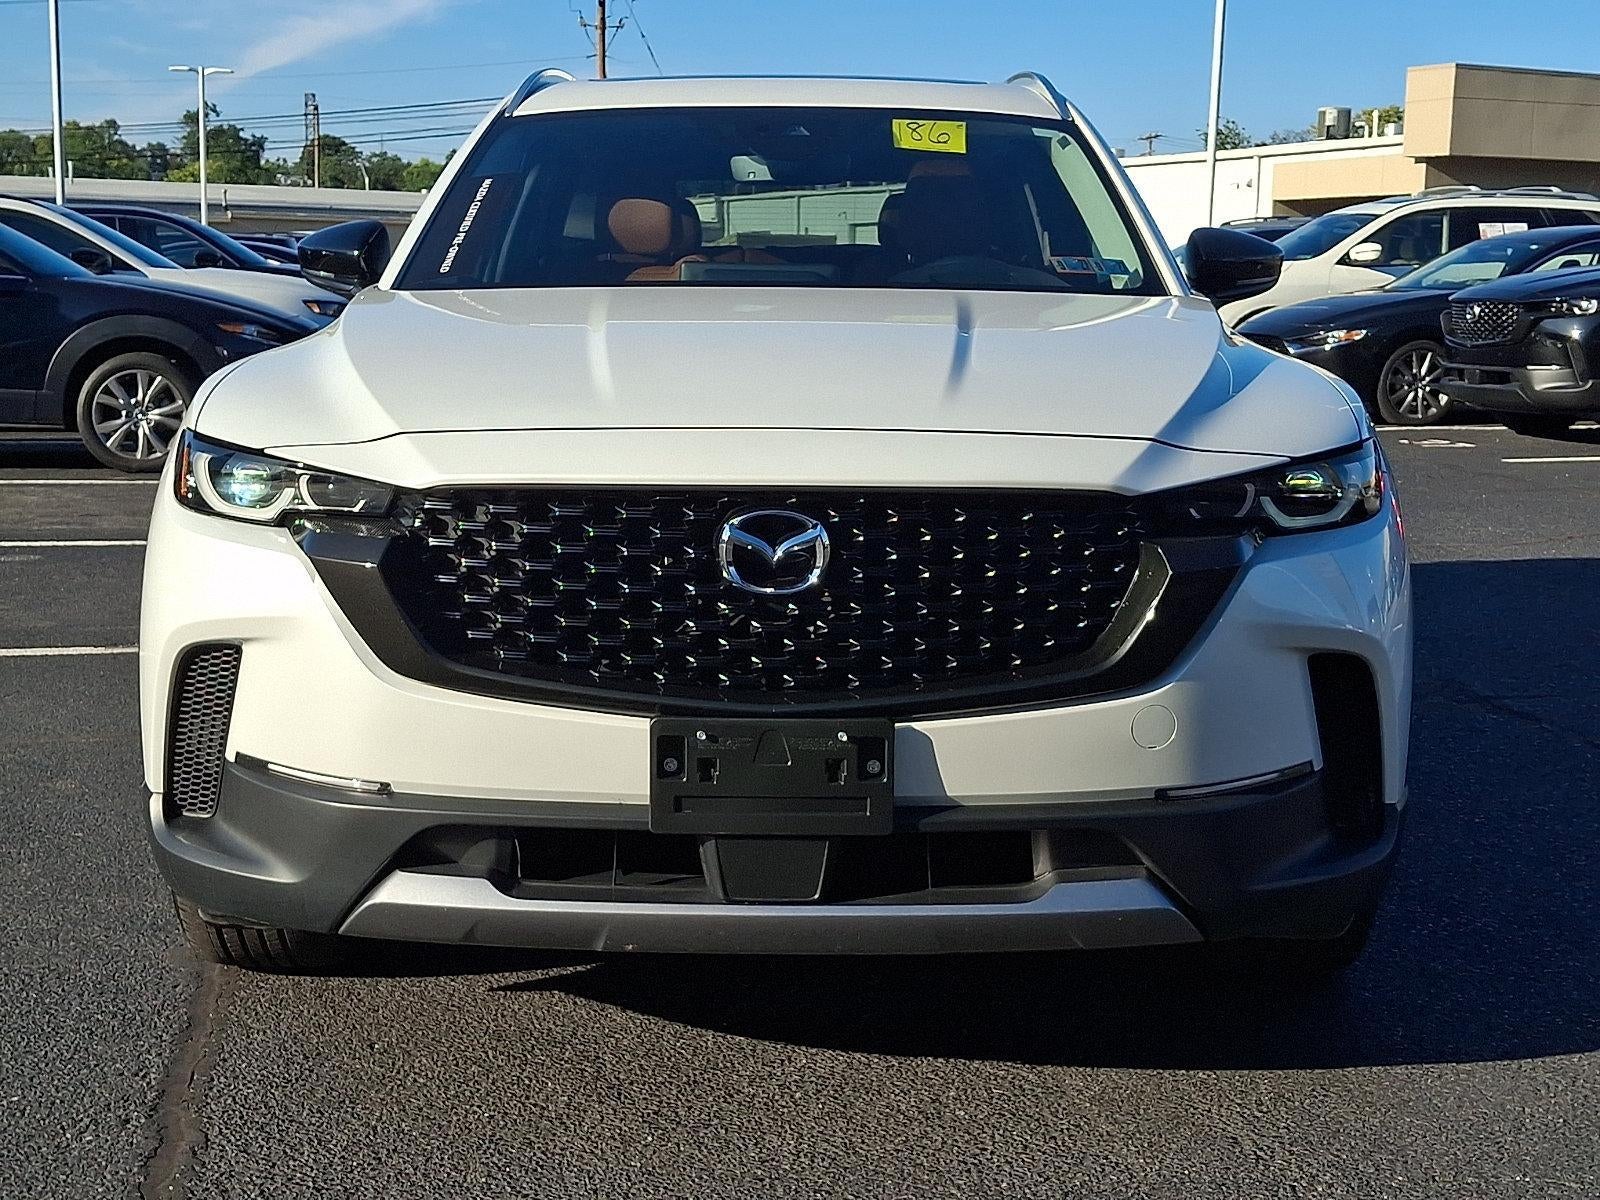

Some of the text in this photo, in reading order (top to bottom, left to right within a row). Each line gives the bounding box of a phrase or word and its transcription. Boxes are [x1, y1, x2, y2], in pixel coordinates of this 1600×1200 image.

[898, 121, 951, 144] 186
[439, 178, 494, 273] MAZDA CERTIFIED PRE-OWNED
